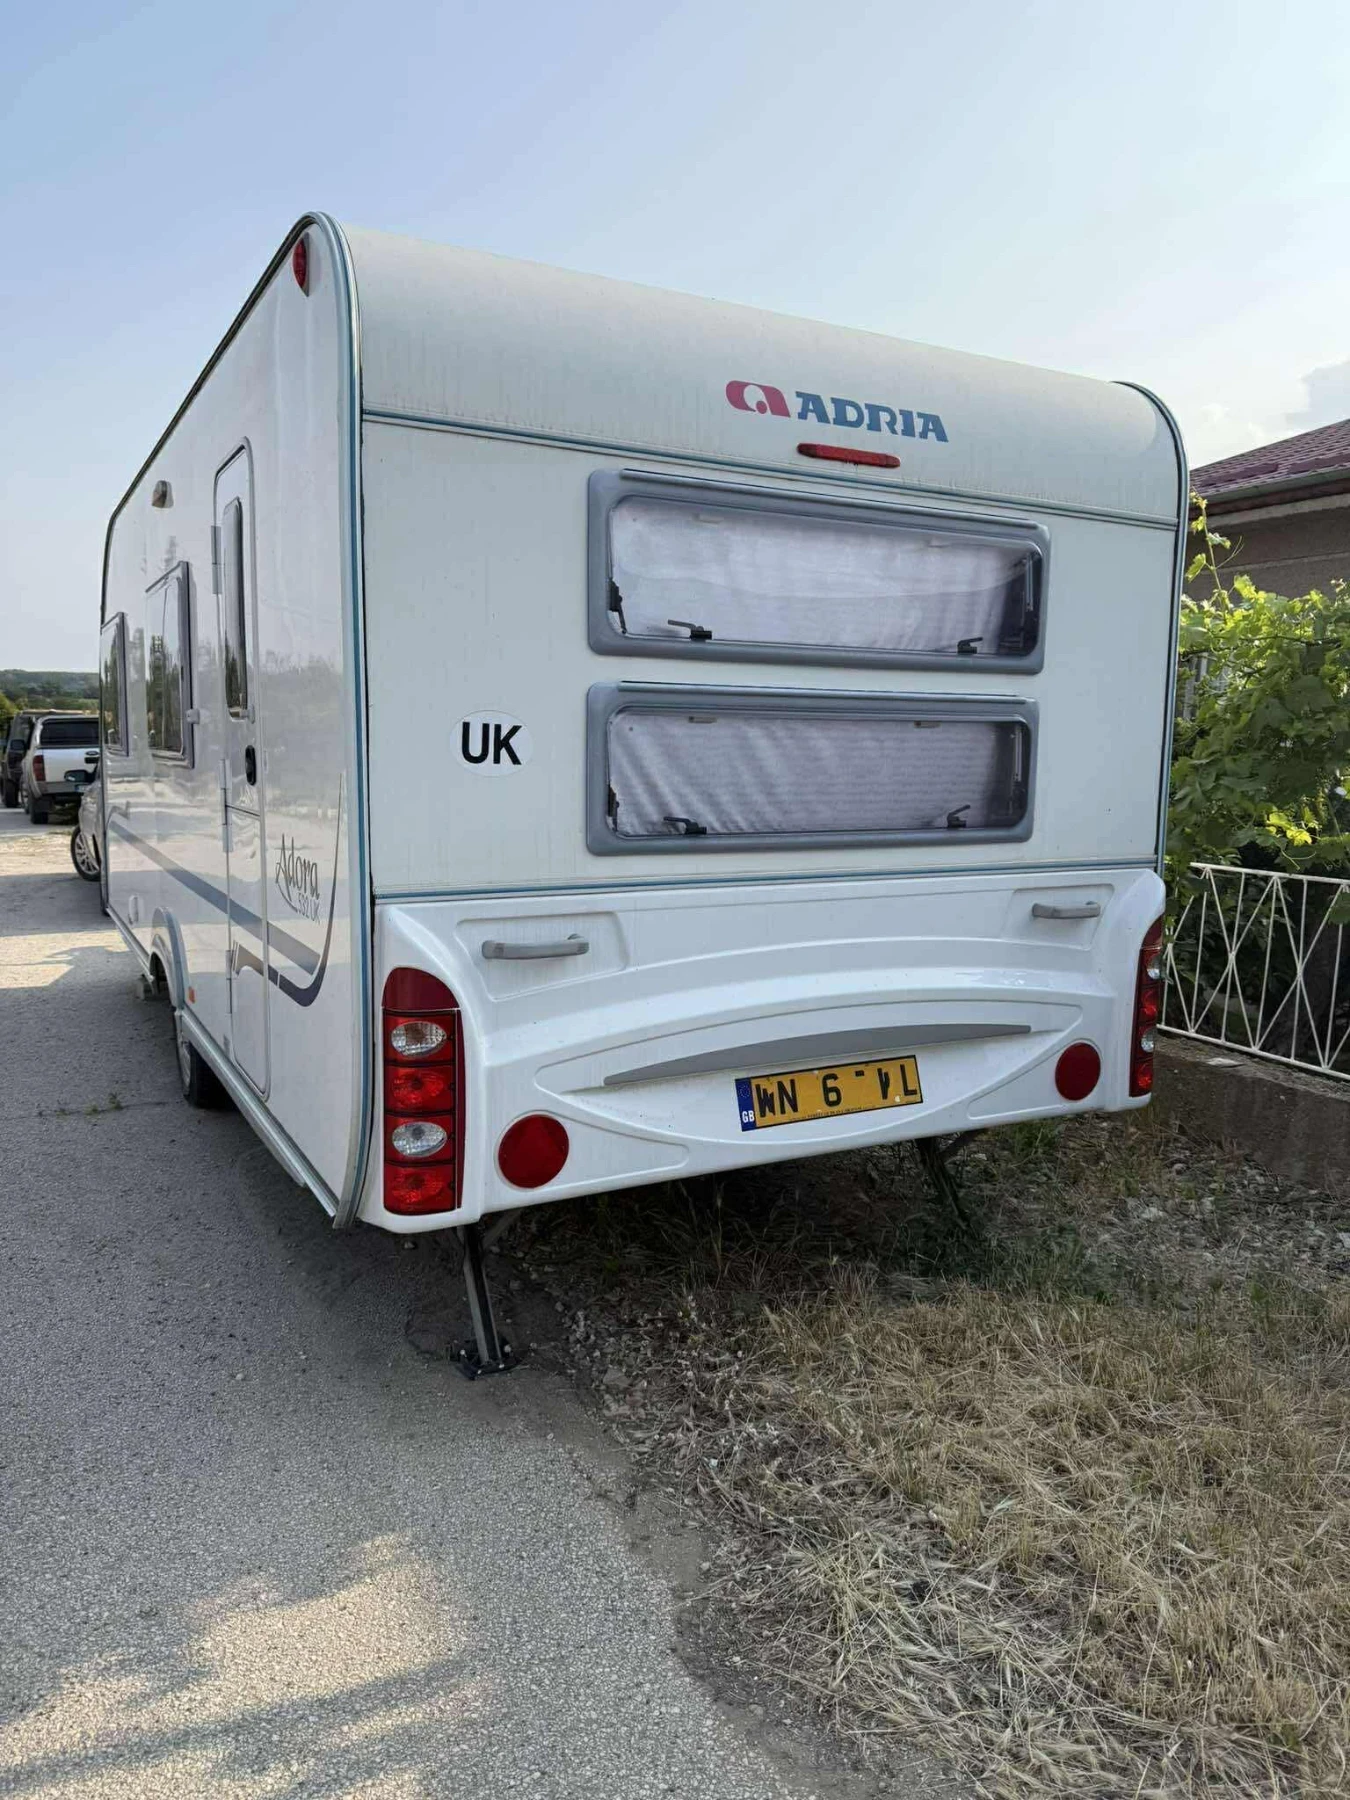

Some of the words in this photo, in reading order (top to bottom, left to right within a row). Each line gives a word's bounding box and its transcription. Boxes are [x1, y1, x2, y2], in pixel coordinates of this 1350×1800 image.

[796, 391, 949, 442] ADRIA
[462, 721, 522, 765] UK
[275, 833, 320, 902] Adora
[742, 1110, 755, 1123] GB
